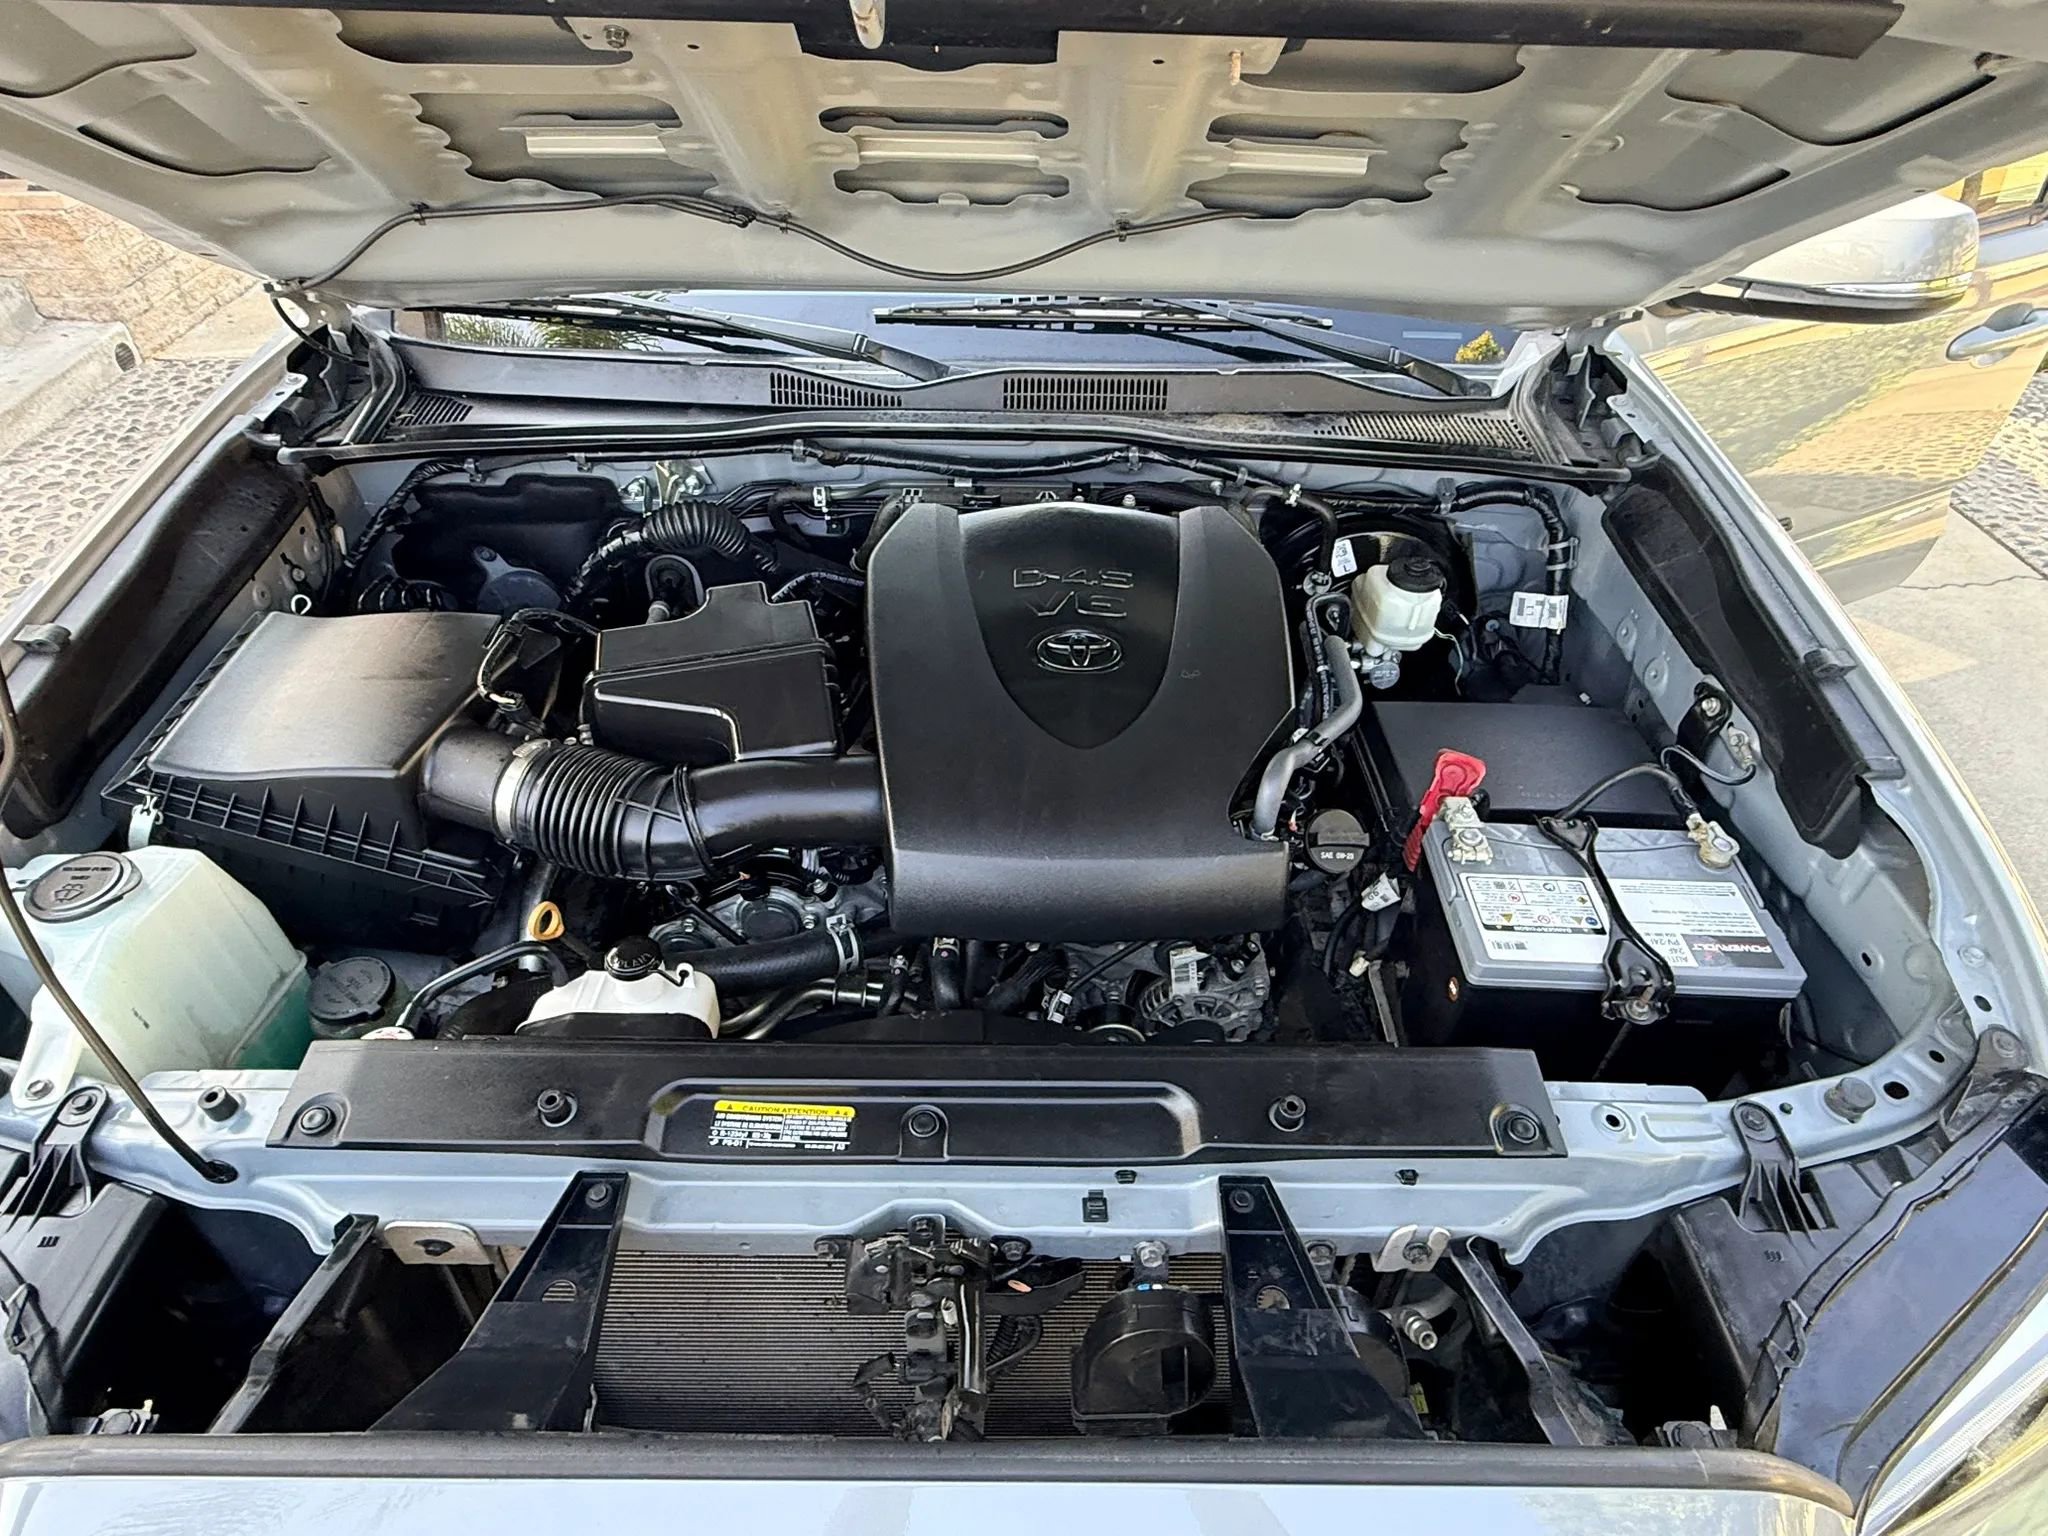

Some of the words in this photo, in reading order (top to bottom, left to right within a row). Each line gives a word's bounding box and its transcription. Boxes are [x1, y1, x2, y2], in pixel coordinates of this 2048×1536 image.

[1013, 568, 1134, 589] D-4S
[1024, 591, 1127, 617] V6
[1320, 851, 1334, 859] SAE
[1692, 942, 1773, 954] POWERVOLT
[742, 1105, 780, 1113] CAUTION
[781, 1107, 829, 1115] ATTENTION
